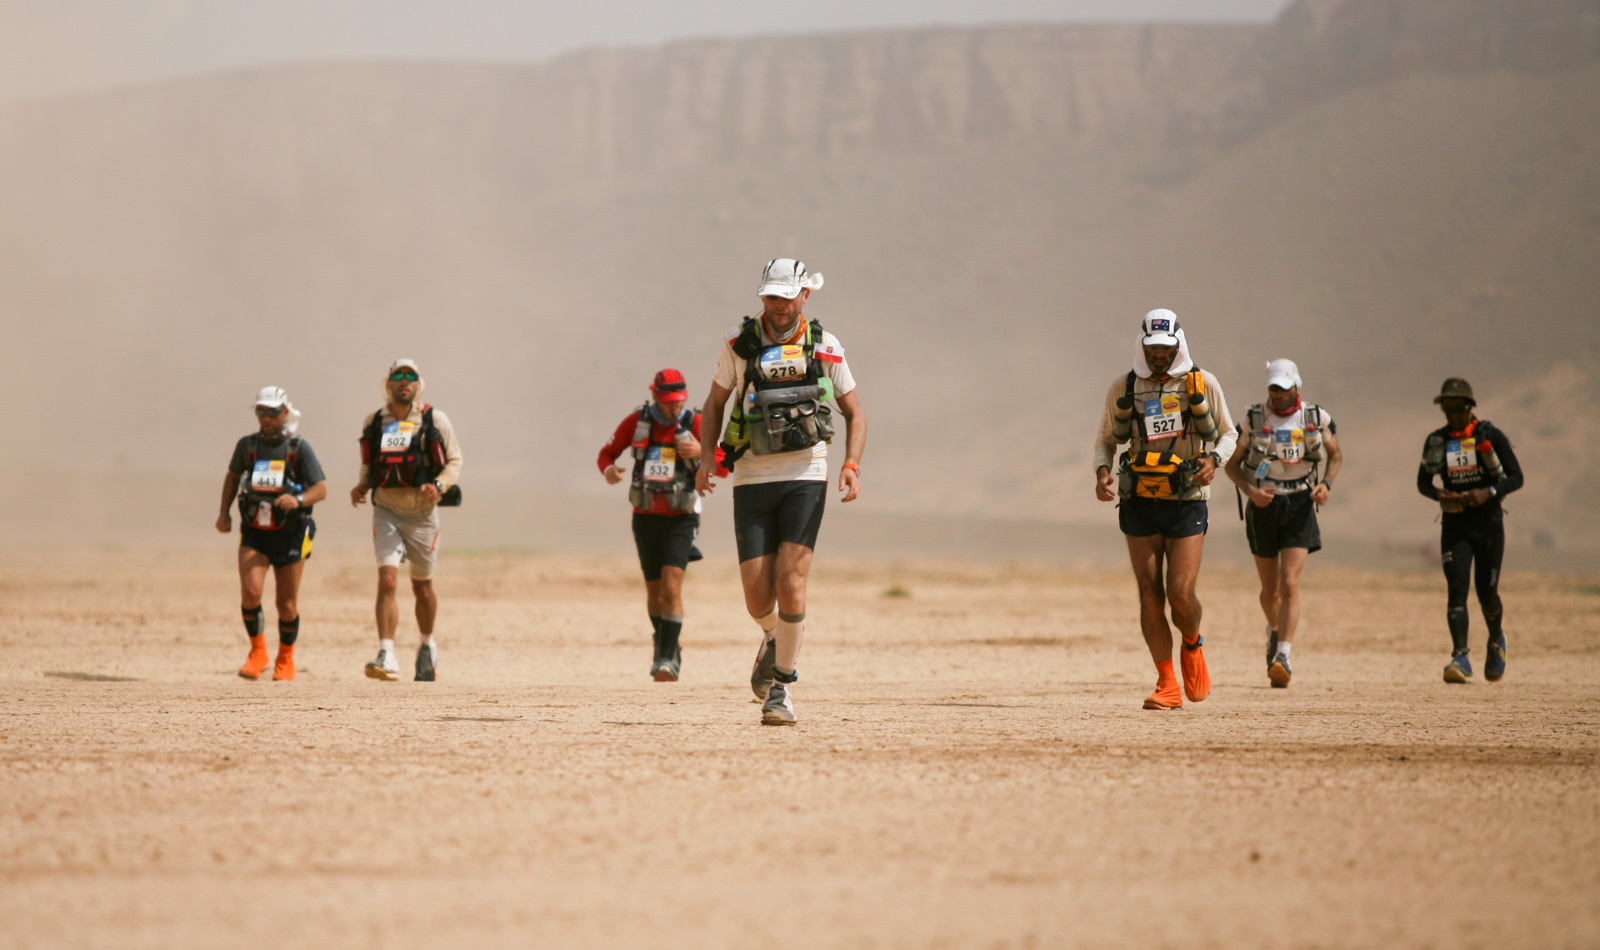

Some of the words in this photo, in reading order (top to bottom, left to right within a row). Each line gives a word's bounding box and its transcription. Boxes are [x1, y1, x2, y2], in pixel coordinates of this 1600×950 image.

[770, 366, 797, 379] 278
[1153, 418, 1175, 433] 527
[386, 437, 406, 446] 502
[1282, 448, 1299, 459] 191
[1456, 455, 1468, 466] 13
[650, 465, 669, 475] 532
[257, 477, 276, 486] 443
